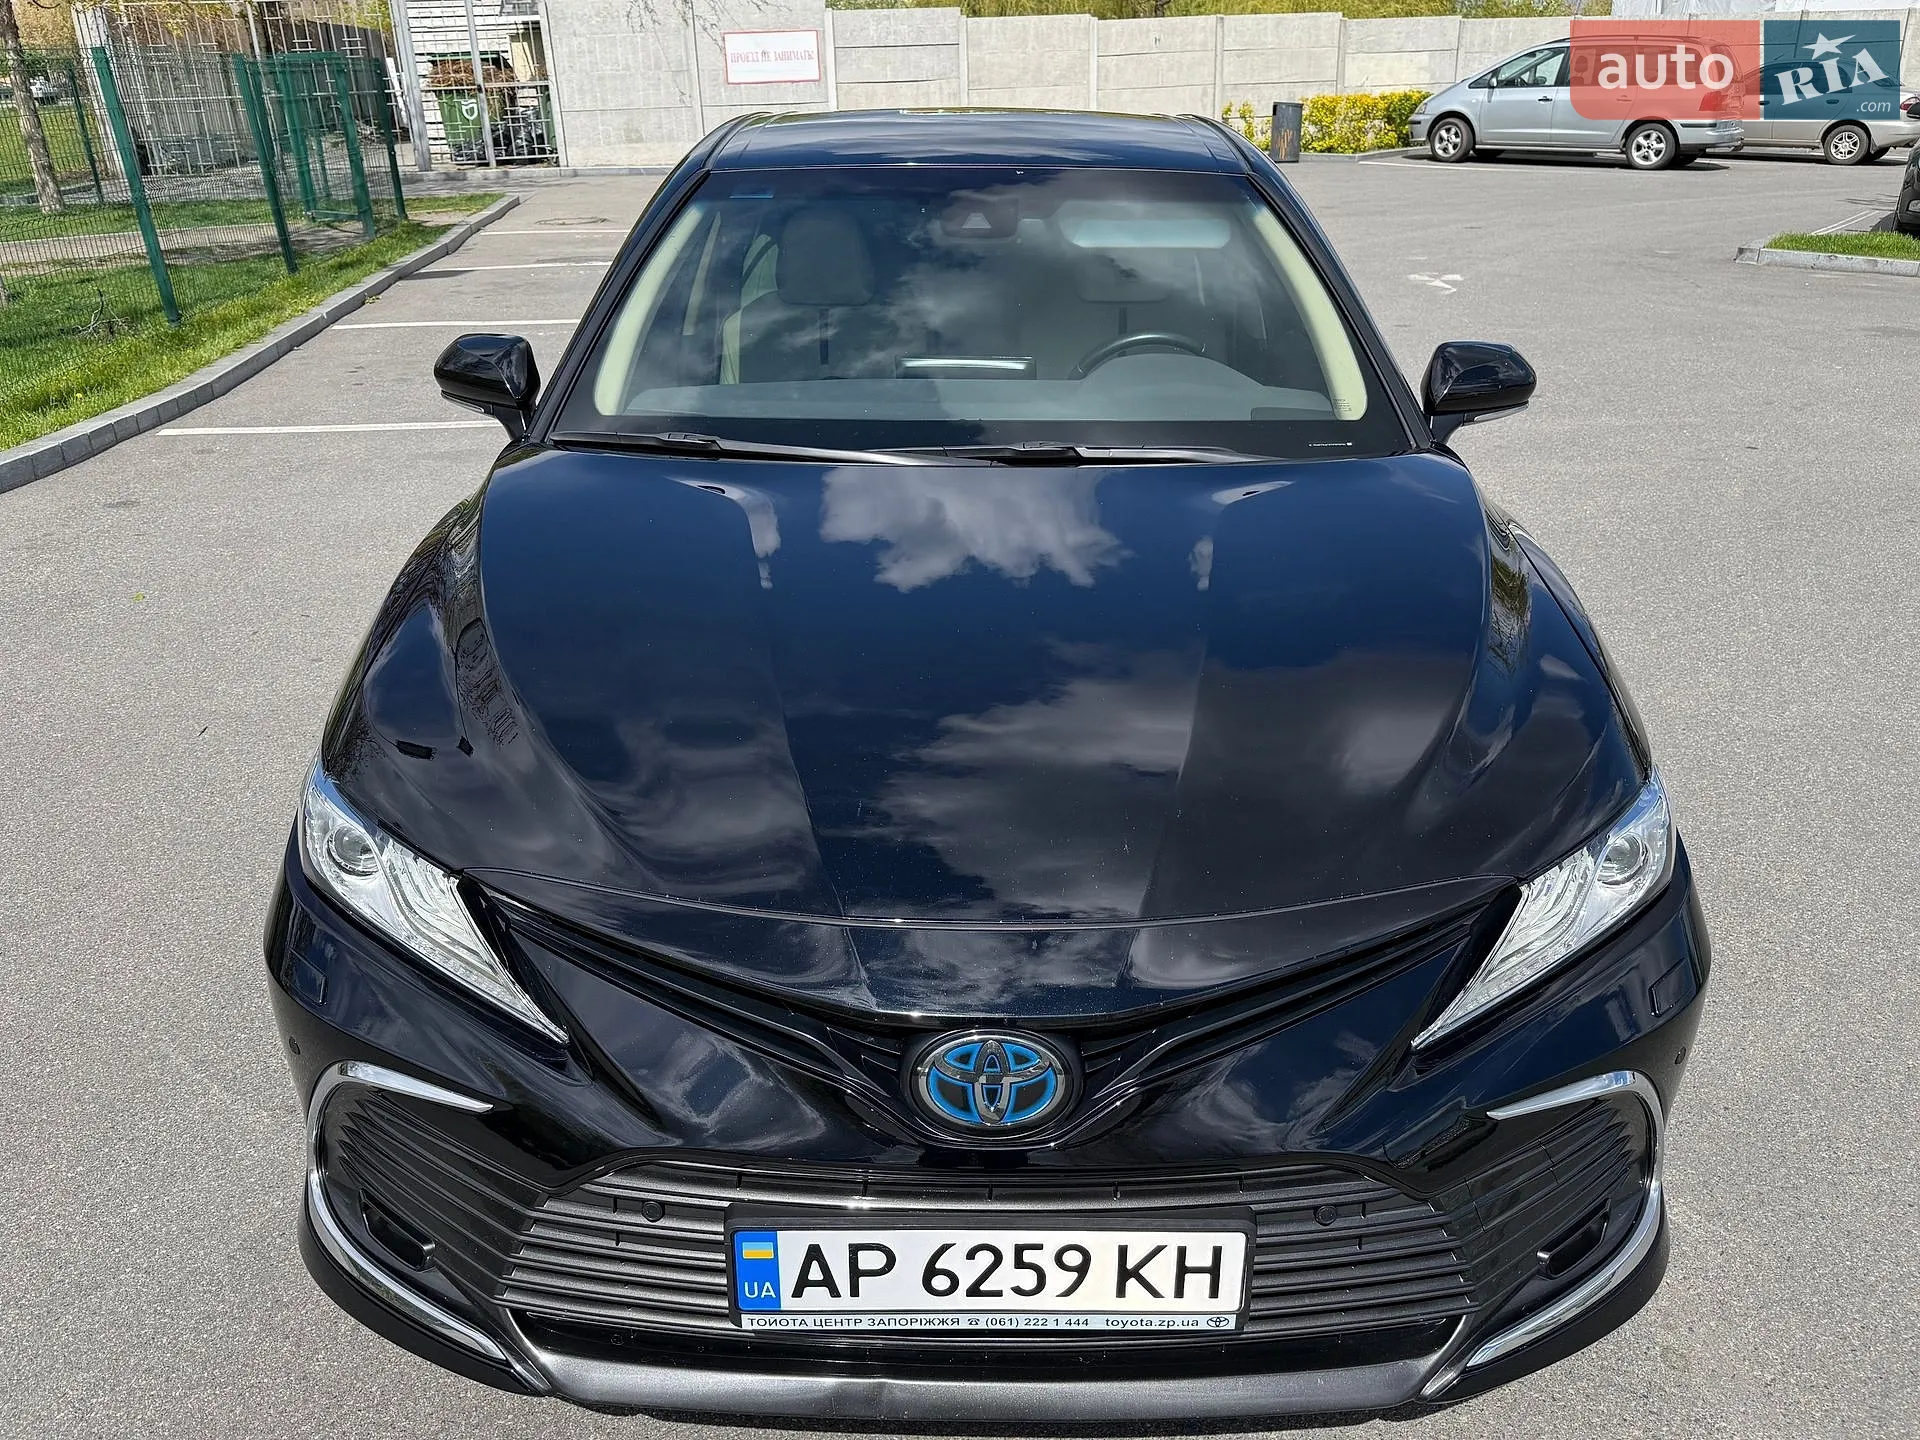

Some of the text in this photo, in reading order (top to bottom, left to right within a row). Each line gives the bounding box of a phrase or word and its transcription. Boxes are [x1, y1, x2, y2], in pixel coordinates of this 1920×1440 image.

[791, 1242, 1223, 1299] AP 6259 KH
[744, 1281, 776, 1298] UA
[813, 1317, 863, 1328] ЦЕНТР
[867, 1317, 960, 1327] ЗАПОРІЖЖЯ
[985, 1317, 1019, 1328] (061)
[1024, 1317, 1048, 1327] 222
[1053, 1317, 1059, 1327] 1
[1064, 1318, 1089, 1327] 444
[1105, 1317, 1199, 1329] toyota.zp.ua
